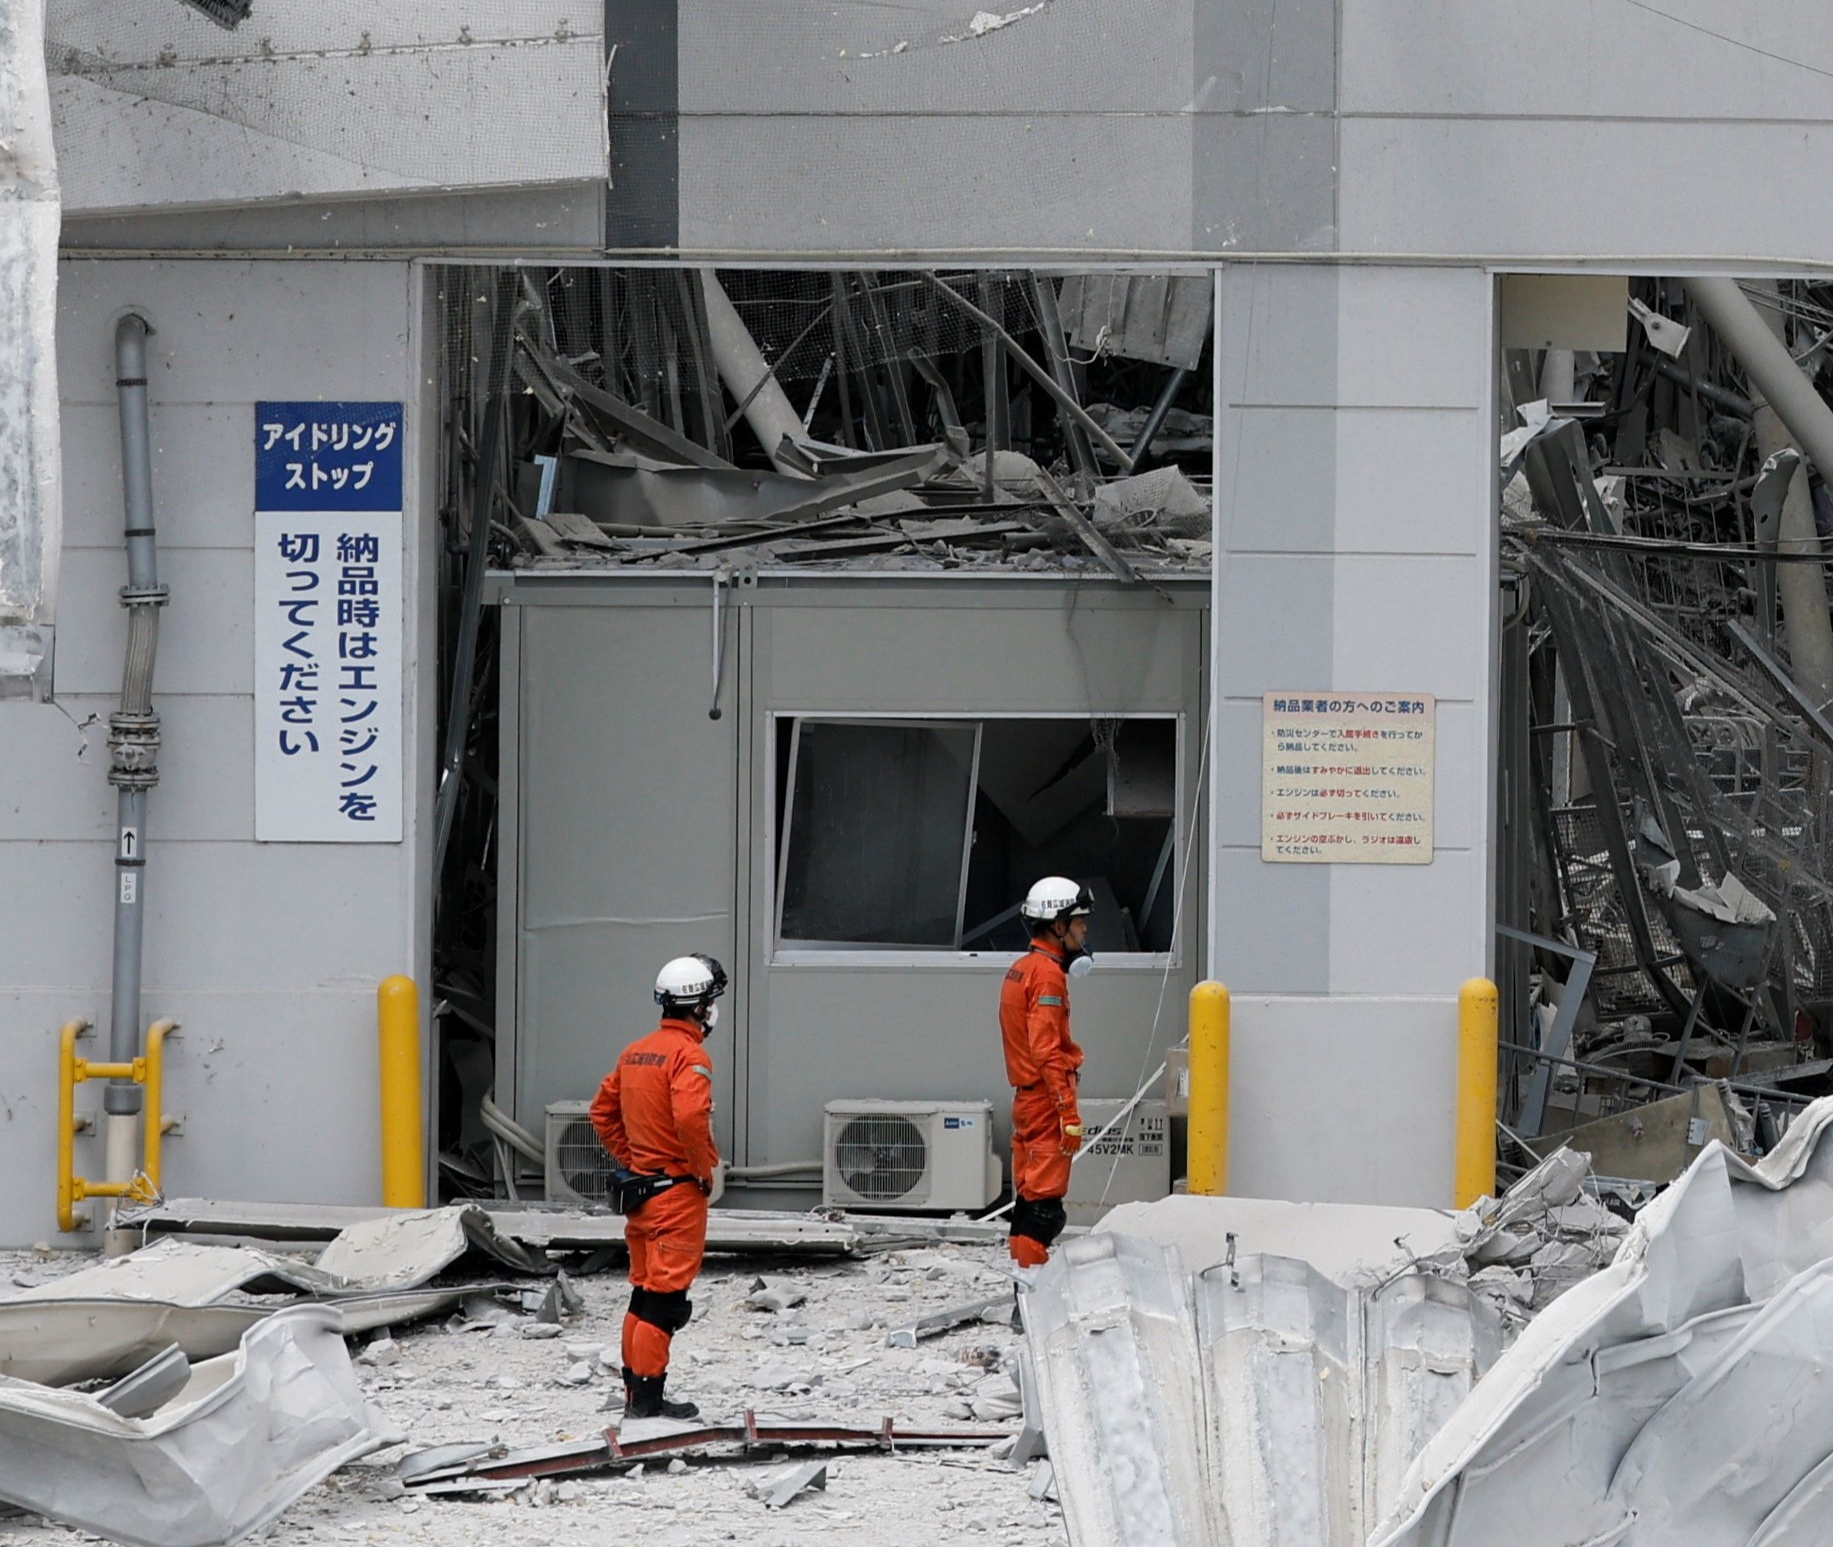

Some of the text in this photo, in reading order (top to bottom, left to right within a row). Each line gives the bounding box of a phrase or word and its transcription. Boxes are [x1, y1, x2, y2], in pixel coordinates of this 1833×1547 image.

[262, 422, 397, 452] アイドリング
[285, 461, 374, 492] ストップ
[277, 532, 320, 757] 切ってください
[336, 532, 380, 822] 納品時はエンジンを
[1273, 698, 1425, 715] 納品業者の方へのご案内
